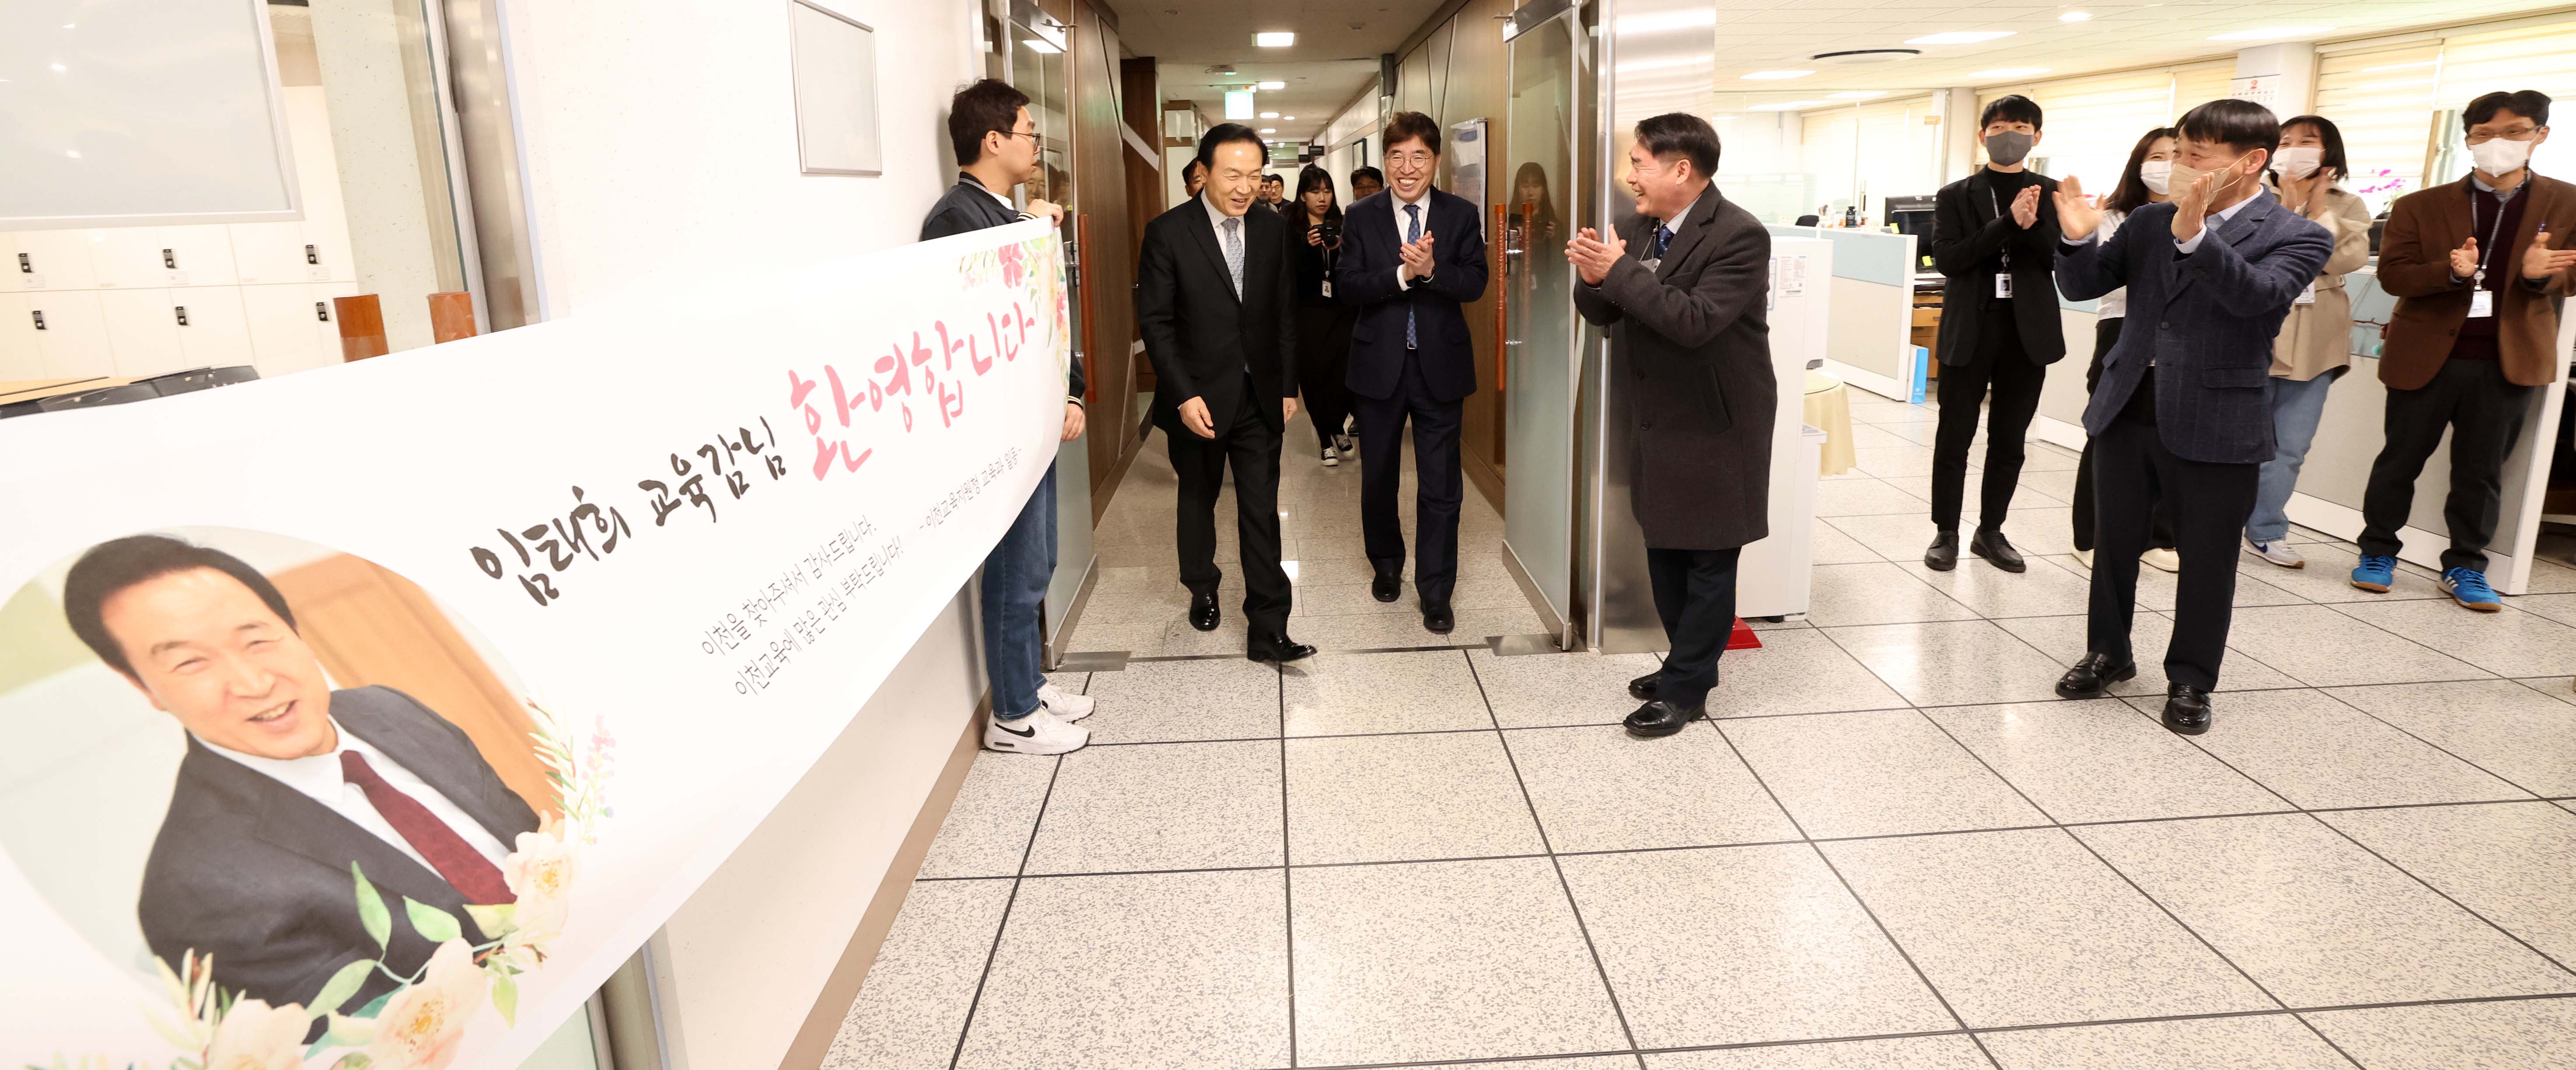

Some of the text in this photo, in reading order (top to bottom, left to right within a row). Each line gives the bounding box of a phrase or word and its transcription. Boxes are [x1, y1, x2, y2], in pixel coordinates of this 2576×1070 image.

[2250, 80, 2258, 90] 2
[469, 302, 1035, 607] 임태희 교육감님 환영합니다
[926, 475, 980, 528] 이천교육지원청
[981, 458, 1004, 486] 교육과
[1005, 447, 1018, 470] 일동
[702, 515, 876, 656] 이천을 찾아주셔서 감사드립니다.
[735, 536, 904, 696] 이천교육에 많은 관심 부탁드립니다!
